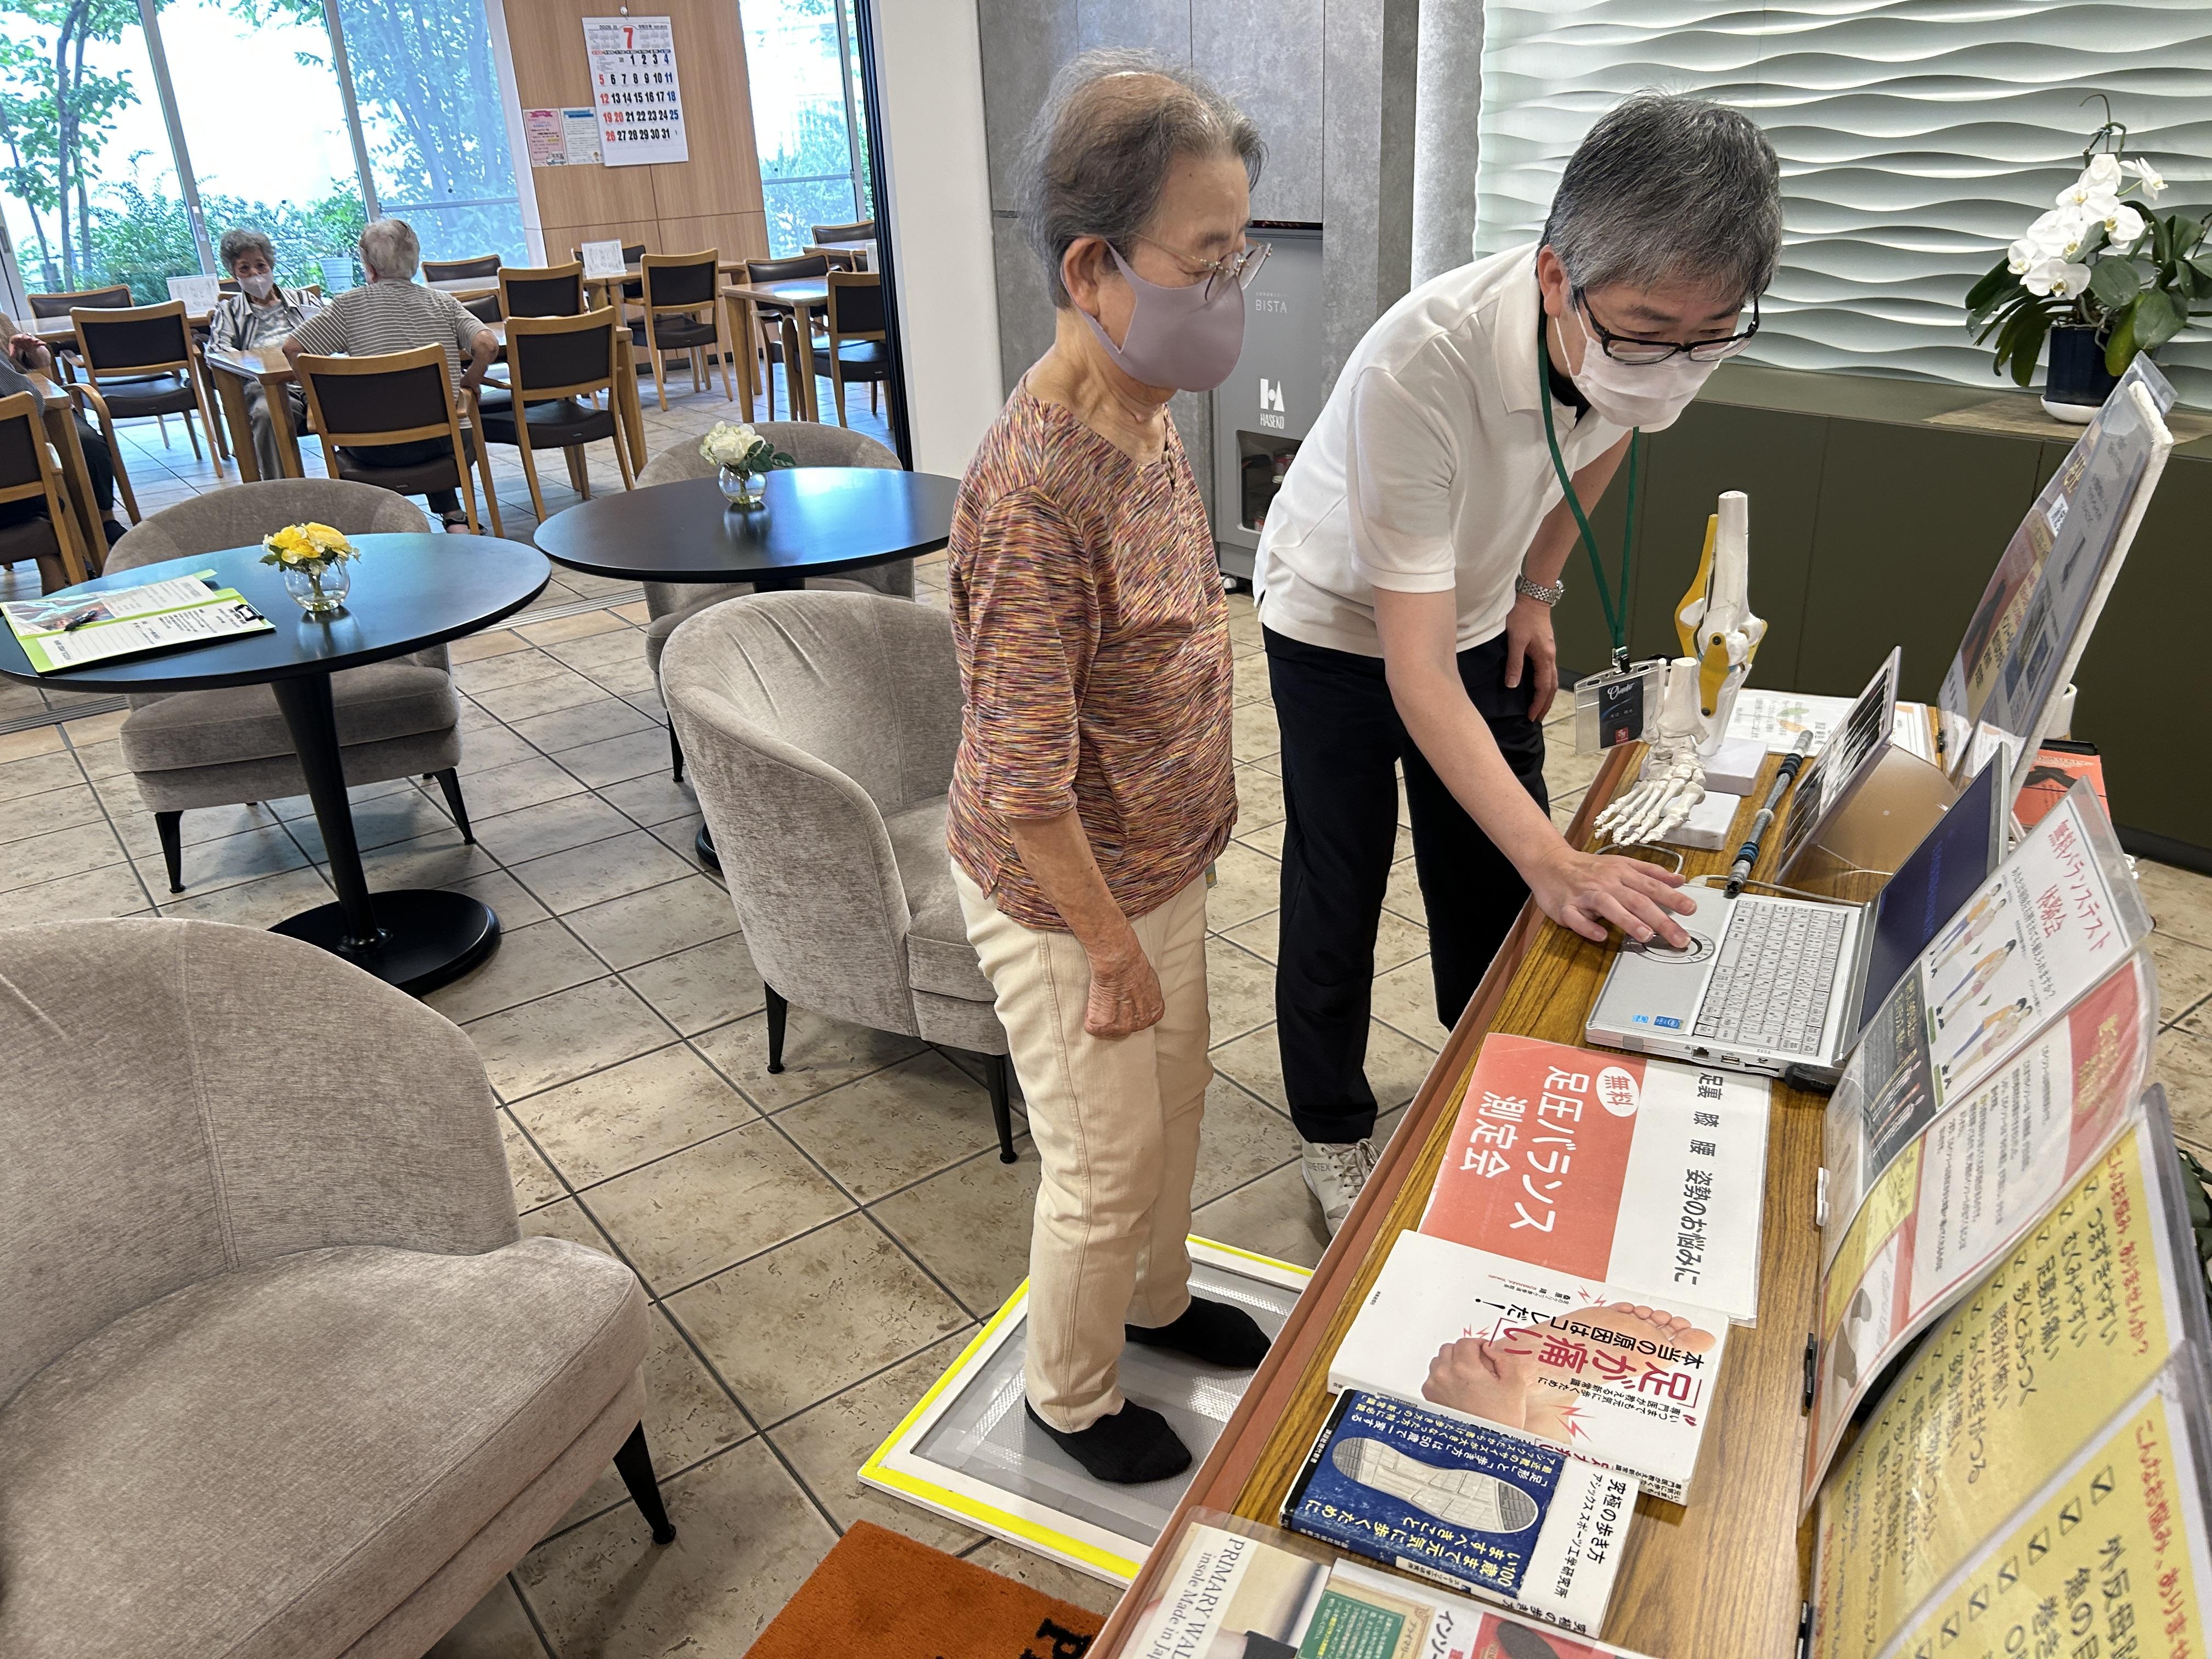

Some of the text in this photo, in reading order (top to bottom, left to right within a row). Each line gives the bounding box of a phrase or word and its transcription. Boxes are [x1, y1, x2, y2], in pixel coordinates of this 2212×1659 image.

[623, 27, 634, 49] 7
[631, 54, 635, 65] 1
[641, 54, 647, 65] 2
[653, 54, 658, 64] 3
[664, 53, 669, 64] 4
[599, 72, 673, 85] 5 6 7 8 9 10 11
[600, 91, 676, 104] 12 13 14 15 16 17 18
[603, 110, 679, 123] 19 20 21 22 23 24 25
[606, 131, 616, 142] 26
[617, 131, 626, 141] 27
[628, 130, 638, 140] 28
[639, 129, 649, 140] 29
[651, 129, 659, 139] 30
[662, 128, 670, 139] 31
[1255, 300, 1287, 314] BISTA
[1260, 413, 1285, 430] HASEKO
[2036, 884, 2068, 939] 体験会
[2048, 819, 2111, 952] 無料バランステスト
[1603, 1074, 1637, 1108] 無料
[1459, 1091, 1530, 1180] 測定会
[1509, 1065, 1590, 1233] 足圧バランス
[1674, 1071, 1723, 1285] 足裏 膝 腰 姿勢のお悩みに
[2060, 1230, 2089, 1348] むくみやすい
[2087, 1207, 2119, 1348] つまずきやすい
[1475, 1298, 1705, 1369] 本当の原因はコレだ！
[2036, 1254, 2061, 1363] 足裏が痛い
[1488, 1317, 1702, 1409] 「足が痛い」
[2012, 1280, 2038, 1407] 歩くとふらつく
[1538, 1377, 1677, 1423] いつまでも元気に歩くために
[1571, 1377, 1681, 1415] 専門医が教える新常識
[1968, 1332, 1988, 1485] ふくらはぎがつる
[1351, 1414, 1549, 1488] 「足形」と「歩き方」は50歳で一変する
[1305, 1499, 1516, 1587] 100歳まで元気に歩くために
[1403, 1516, 1522, 1561] いますべきこと
[1553, 1474, 1603, 1599] アシックス スポーツ工学研究所
[1587, 1478, 1627, 1564] 究極の歩き方
[1188, 1552, 1212, 1588] insole
[1195, 1537, 1246, 1617] PRIMARY
[1161, 1627, 1180, 1640] in
[1170, 1592, 1198, 1625] Made
[1502, 1598, 1588, 1635] 究極の歩き方
